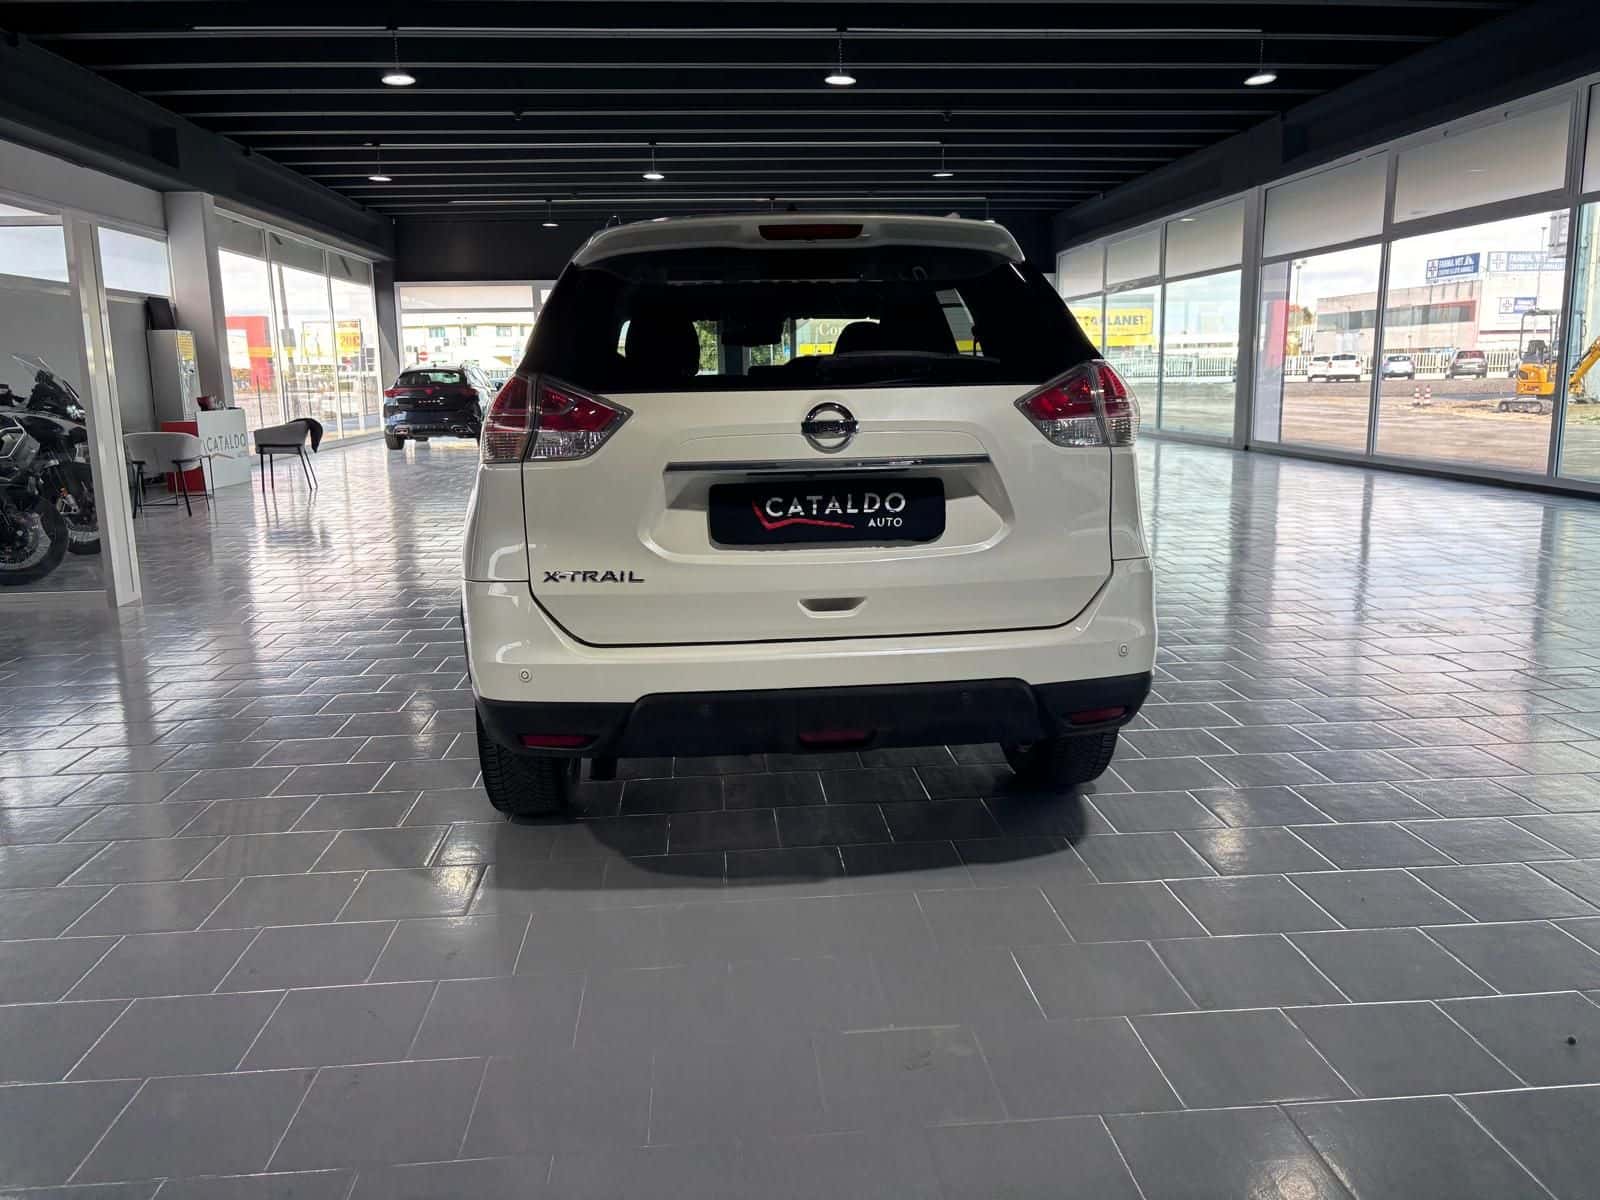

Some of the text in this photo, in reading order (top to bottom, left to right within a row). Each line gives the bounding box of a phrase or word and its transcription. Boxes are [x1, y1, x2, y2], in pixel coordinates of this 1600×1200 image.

[206, 433, 246, 452] CATALDO
[765, 492, 906, 517] CATALDO
[868, 517, 903, 528] AUTO
[543, 570, 645, 583] X-TRAIL
